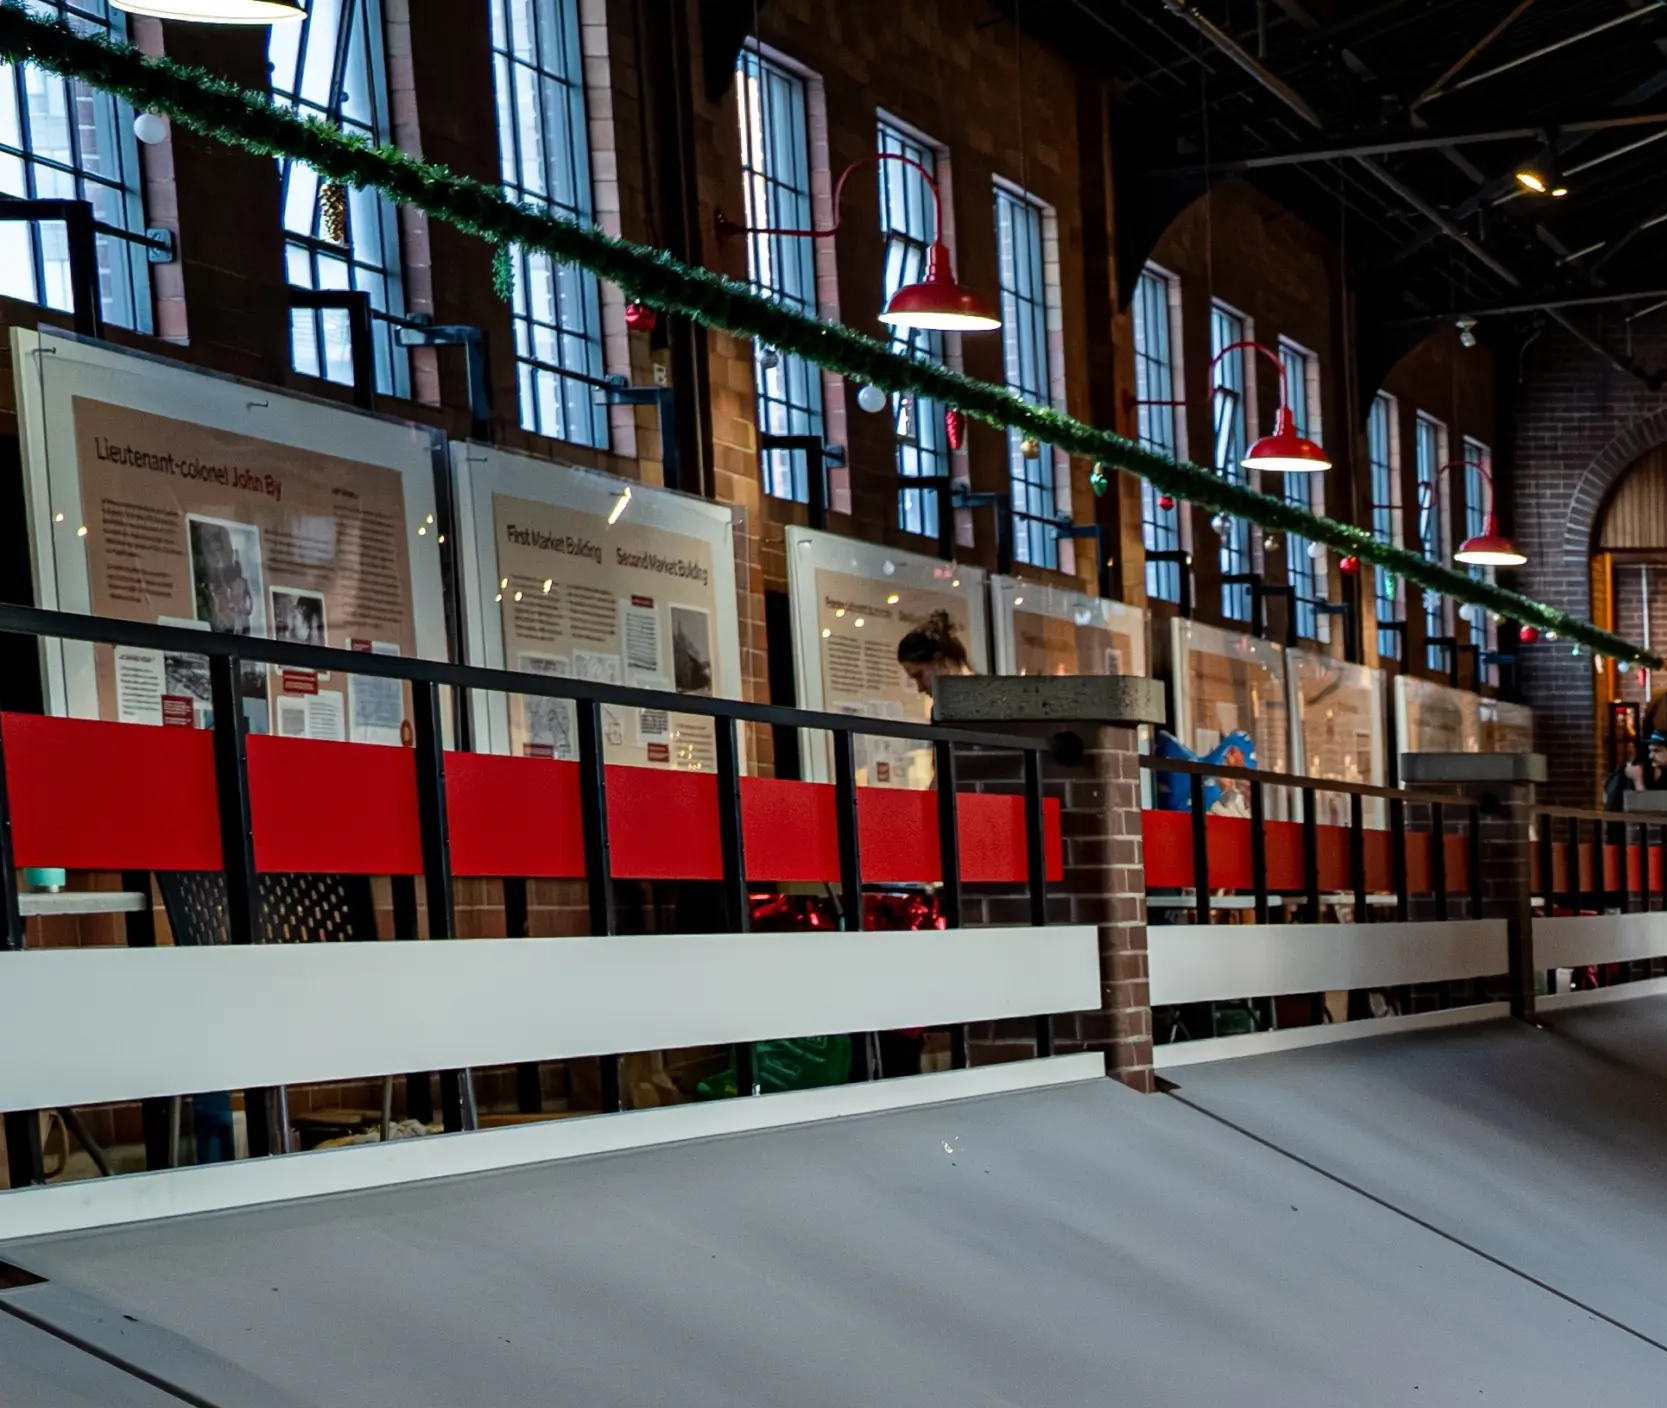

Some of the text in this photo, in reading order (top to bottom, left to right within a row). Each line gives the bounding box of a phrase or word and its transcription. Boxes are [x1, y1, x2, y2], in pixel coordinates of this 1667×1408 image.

[94, 436, 282, 502] Lieutenant-colonel John By
[506, 524, 603, 565] First Market Building
[615, 547, 709, 586] Second Market Building
